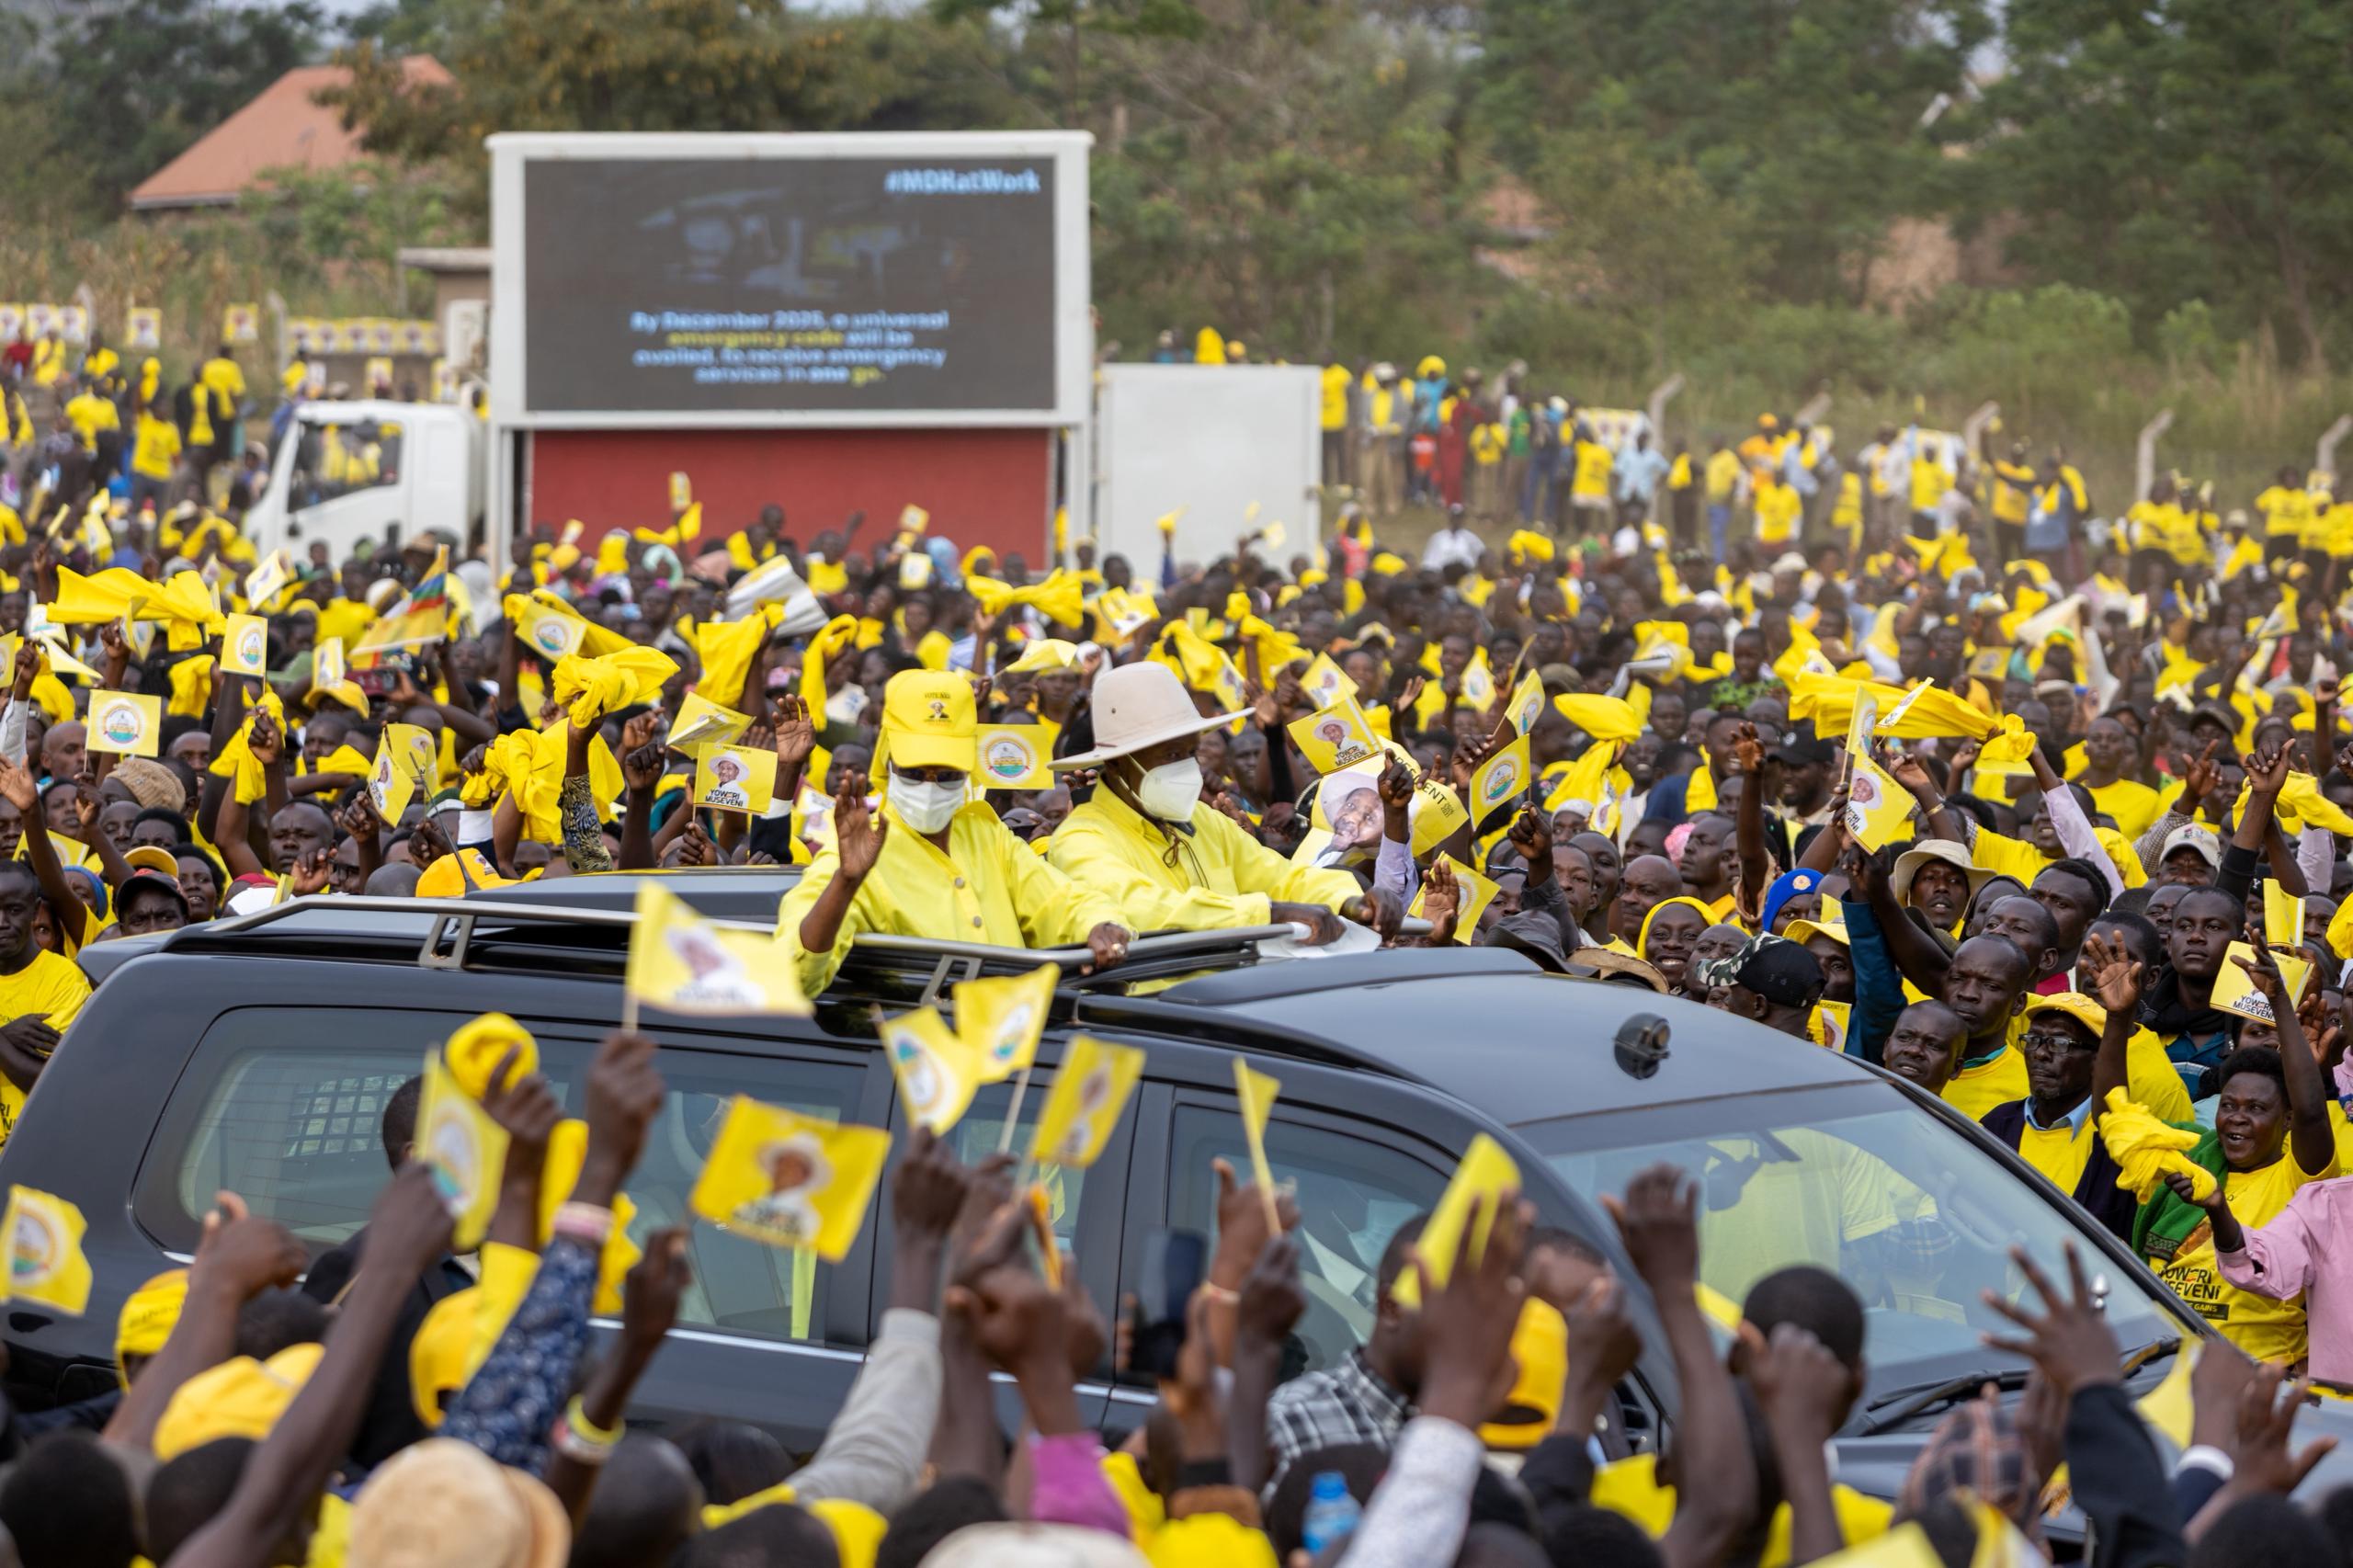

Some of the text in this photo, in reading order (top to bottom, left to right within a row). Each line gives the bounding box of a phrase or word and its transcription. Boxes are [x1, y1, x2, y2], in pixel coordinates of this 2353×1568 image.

[631, 311, 660, 335] By
[661, 311, 769, 331] December
[831, 313, 848, 331] a
[851, 311, 949, 331] universal
[666, 328, 914, 348] emergency code will be
[720, 347, 745, 365] to
[746, 347, 825, 366] receive
[827, 348, 947, 369] emergency
[694, 366, 886, 388] services in one go.
[705, 796, 744, 807] MUSEVENI
[710, 789, 740, 800] YOWERI
[2193, 1303, 2218, 1312] GAINS
